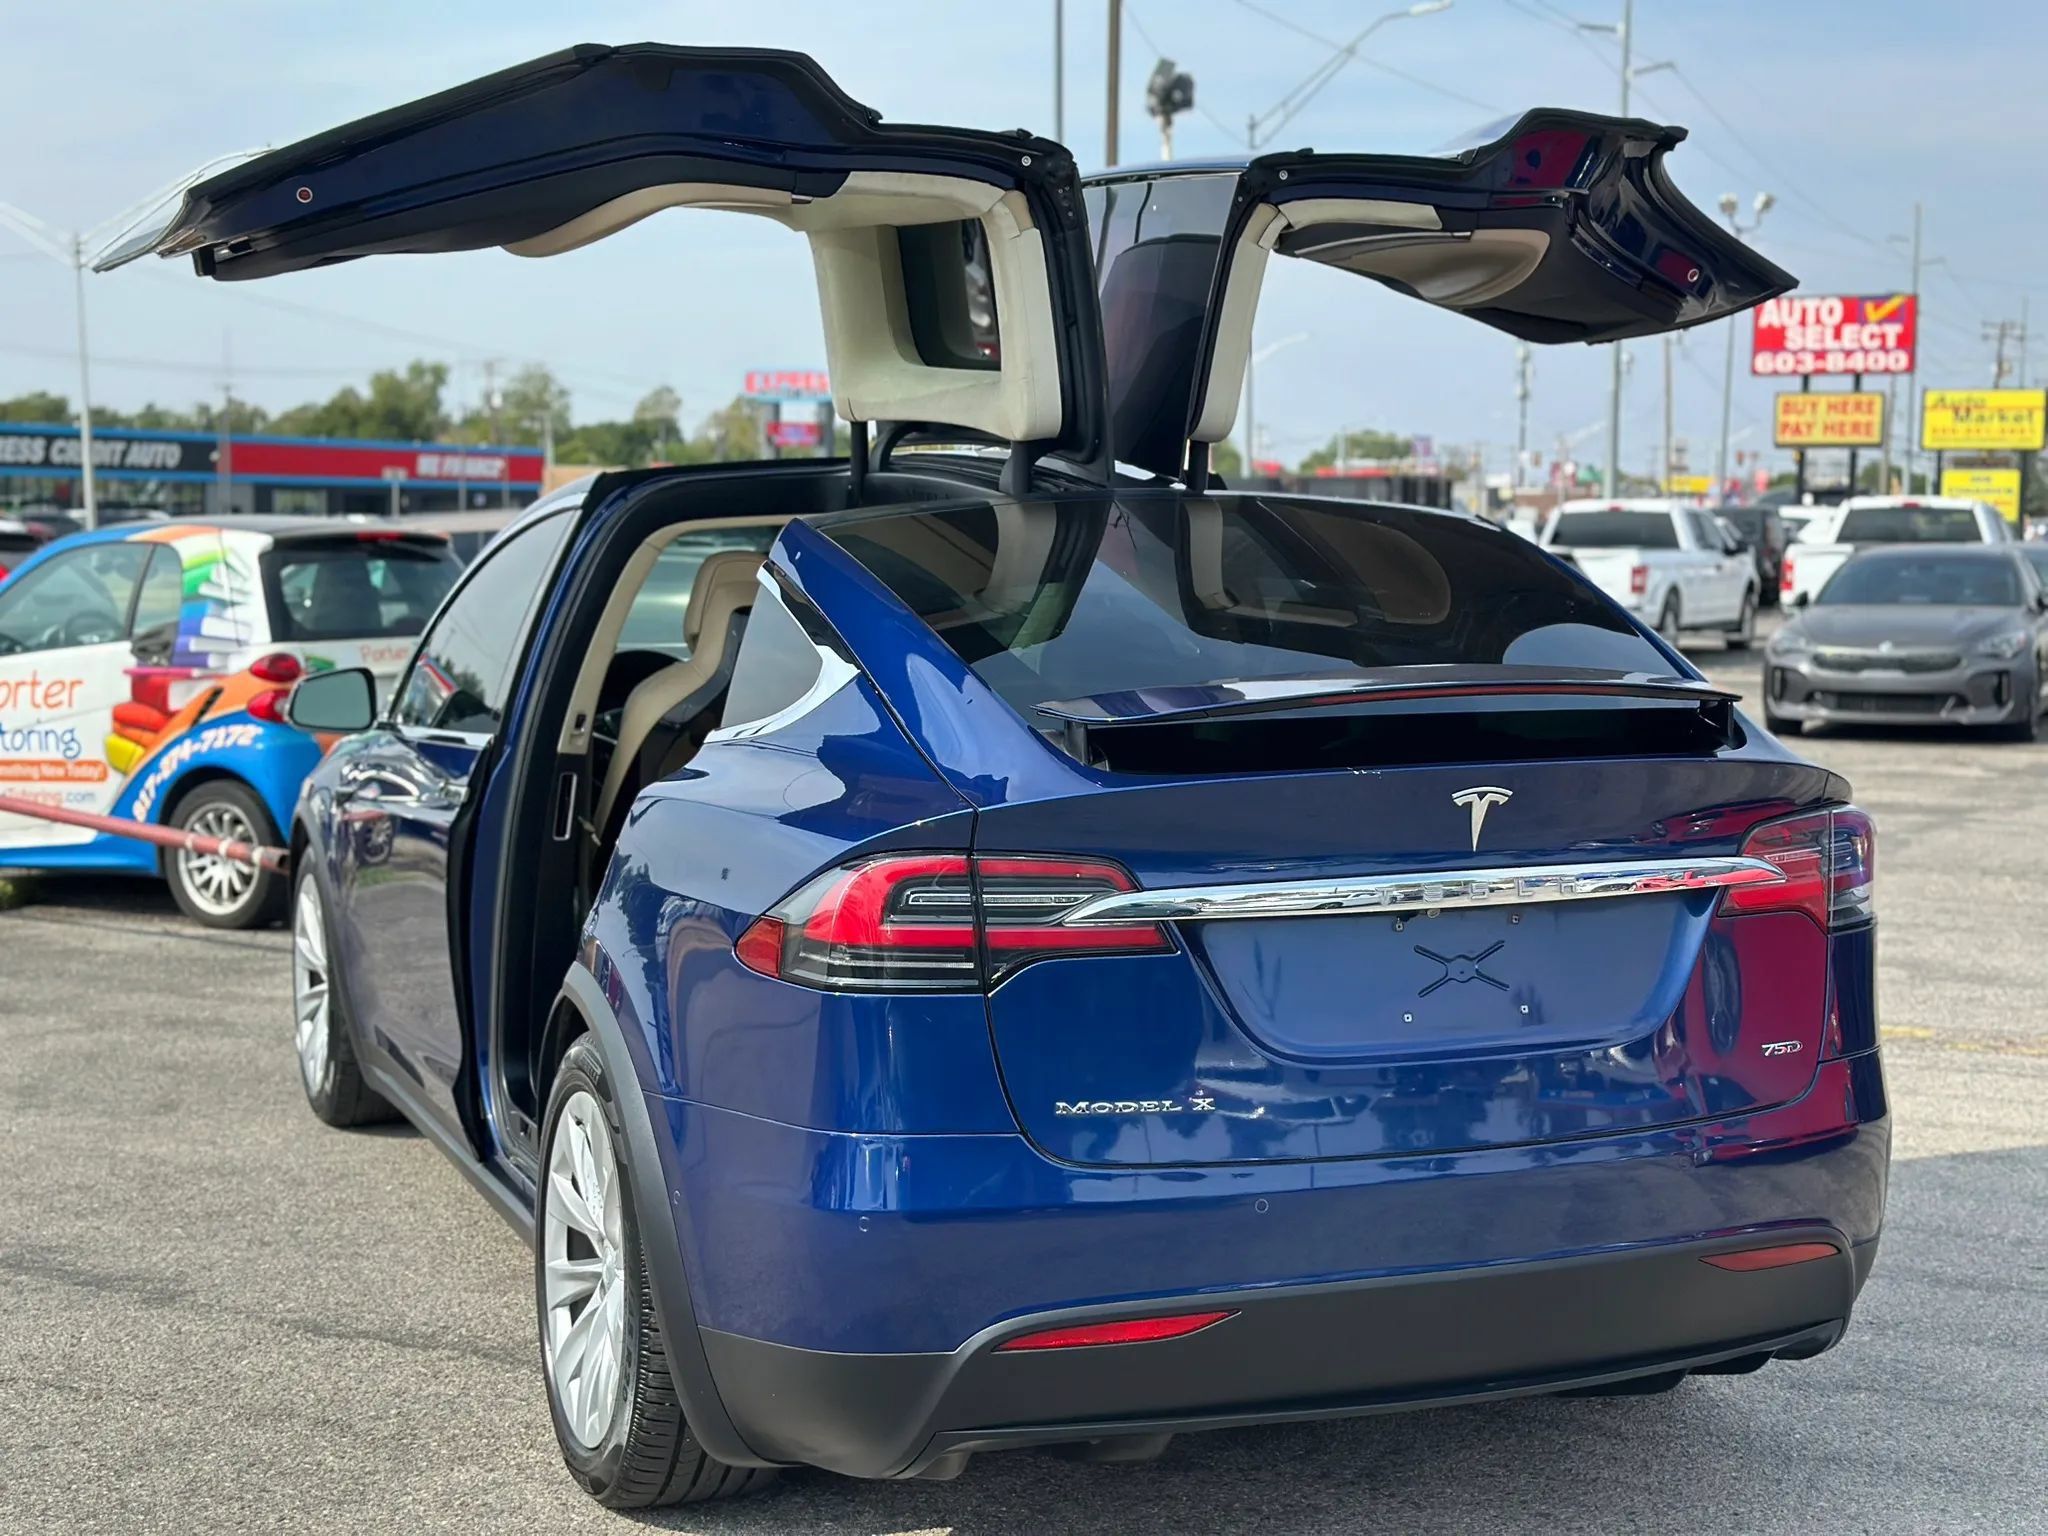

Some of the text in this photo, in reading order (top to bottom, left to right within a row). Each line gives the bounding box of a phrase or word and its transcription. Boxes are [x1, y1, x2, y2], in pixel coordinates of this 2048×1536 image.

[1758, 297, 1844, 328] AUTO
[1784, 322, 1903, 351] SELECT
[1782, 400, 1875, 415] BUY HERE
[1780, 422, 1873, 437] PAY HERE
[124, 440, 182, 468] AUTO
[1375, 876, 1578, 905] TESLA
[1761, 1041, 1803, 1057] 75D
[1055, 1097, 1216, 1114] MODEL X
